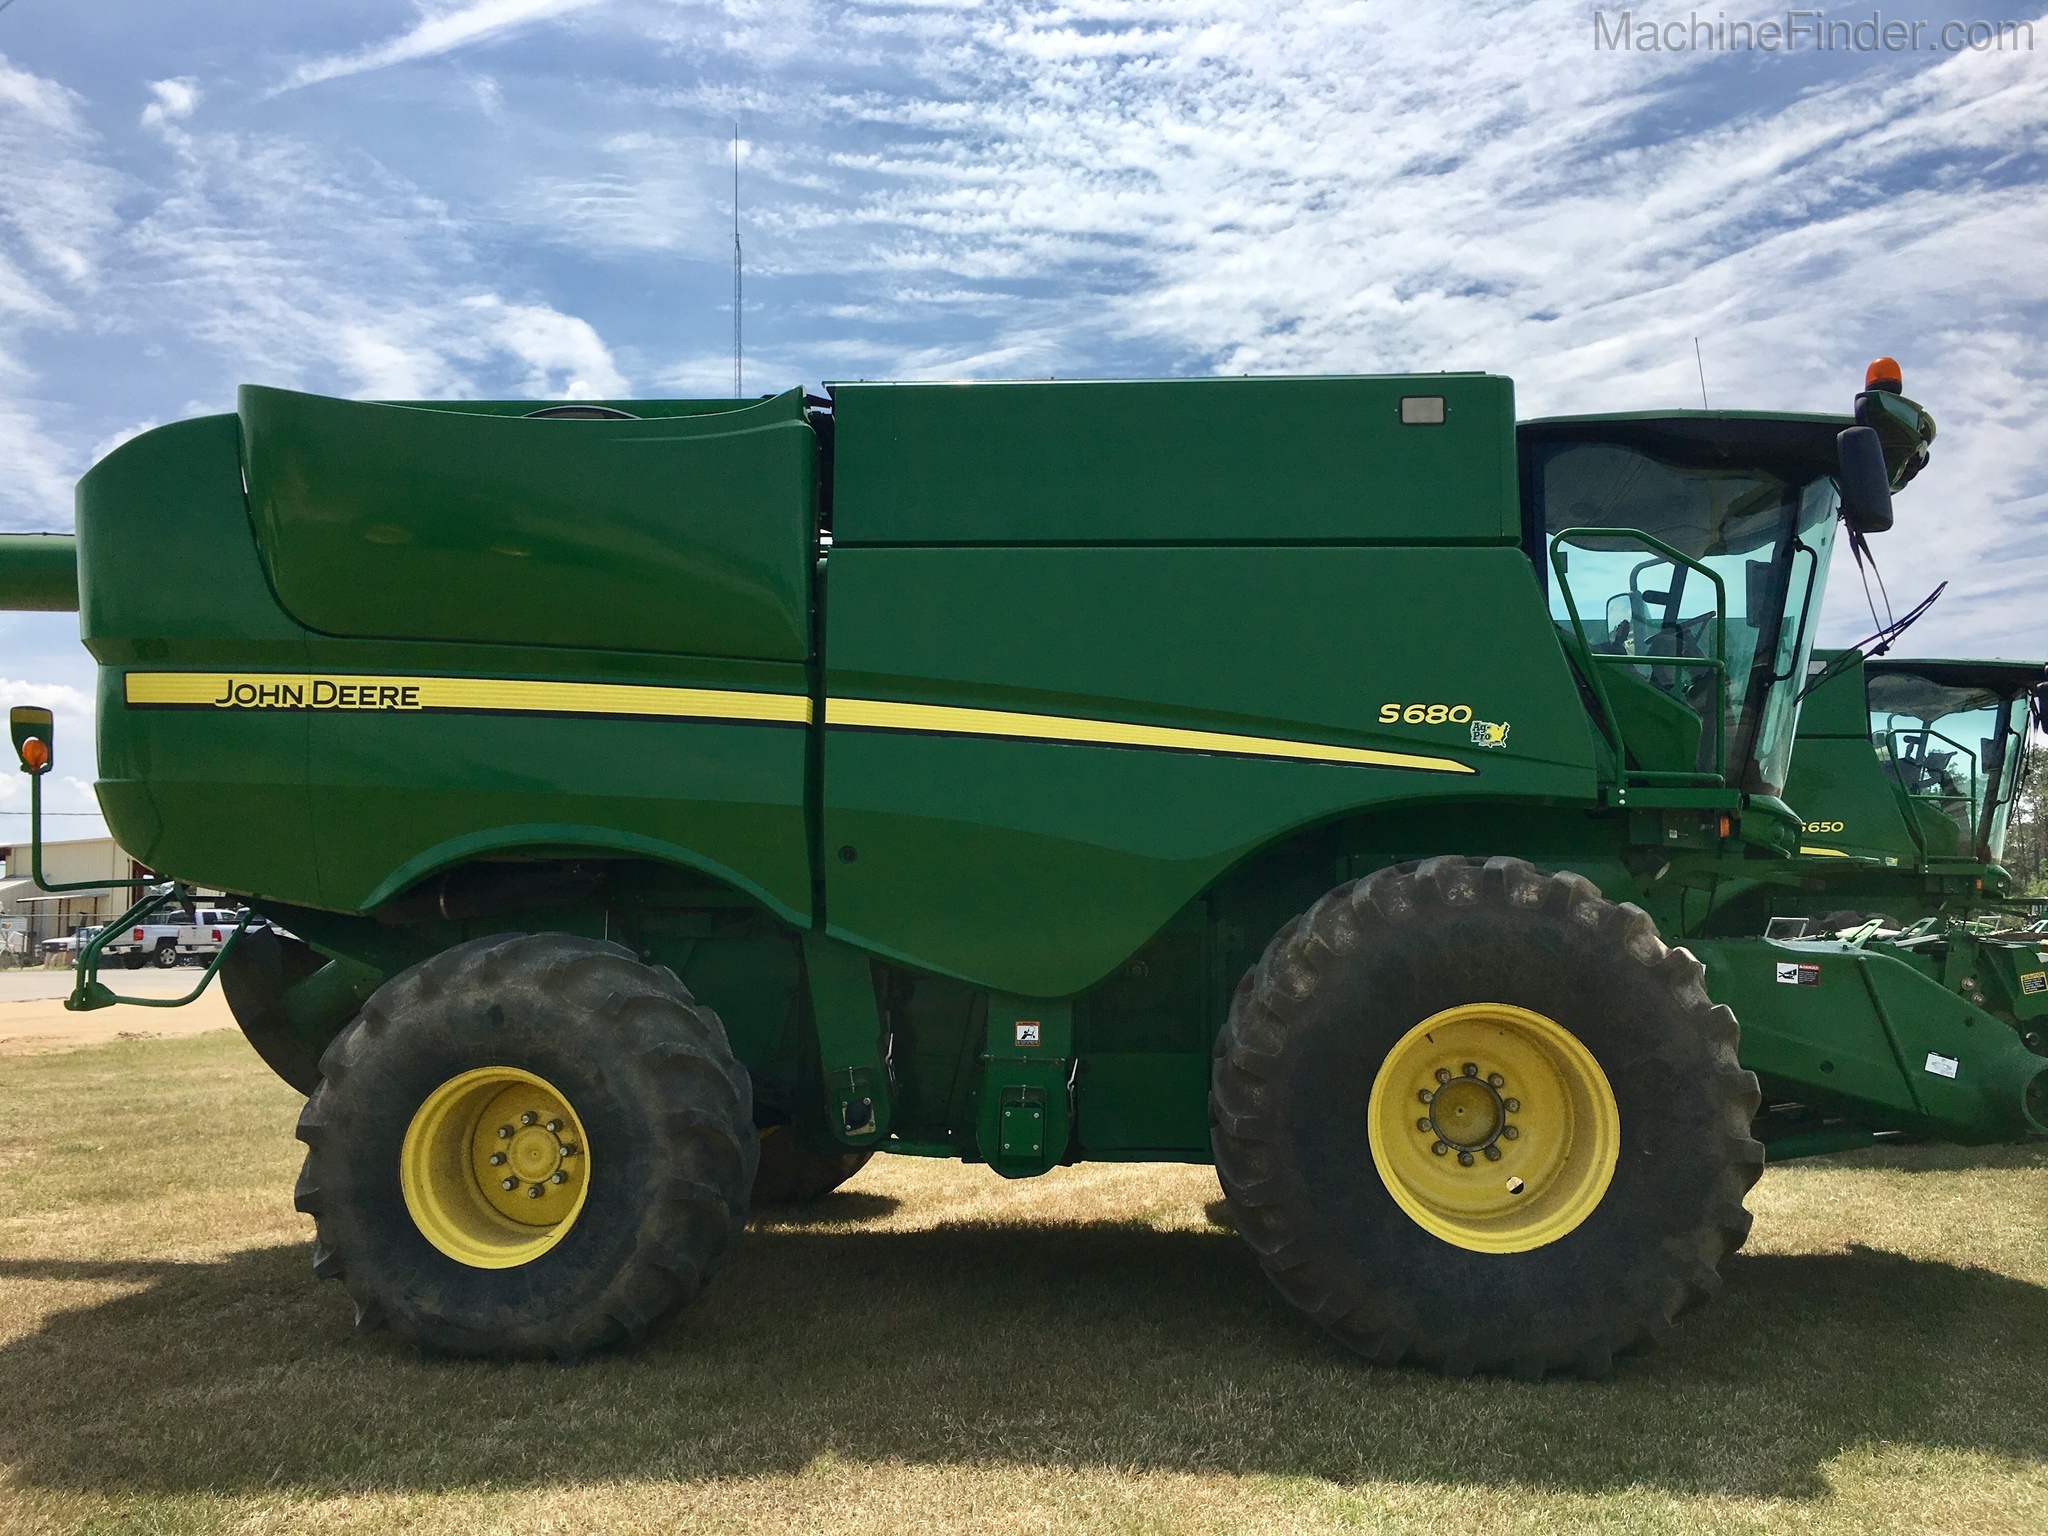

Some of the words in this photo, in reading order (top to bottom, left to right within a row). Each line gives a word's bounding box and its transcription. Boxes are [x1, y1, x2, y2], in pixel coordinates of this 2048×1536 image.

[215, 679, 303, 705] JOHN
[313, 680, 420, 707] DEERE
[1378, 702, 1473, 725] S680
[1473, 732, 1491, 740] Pro
